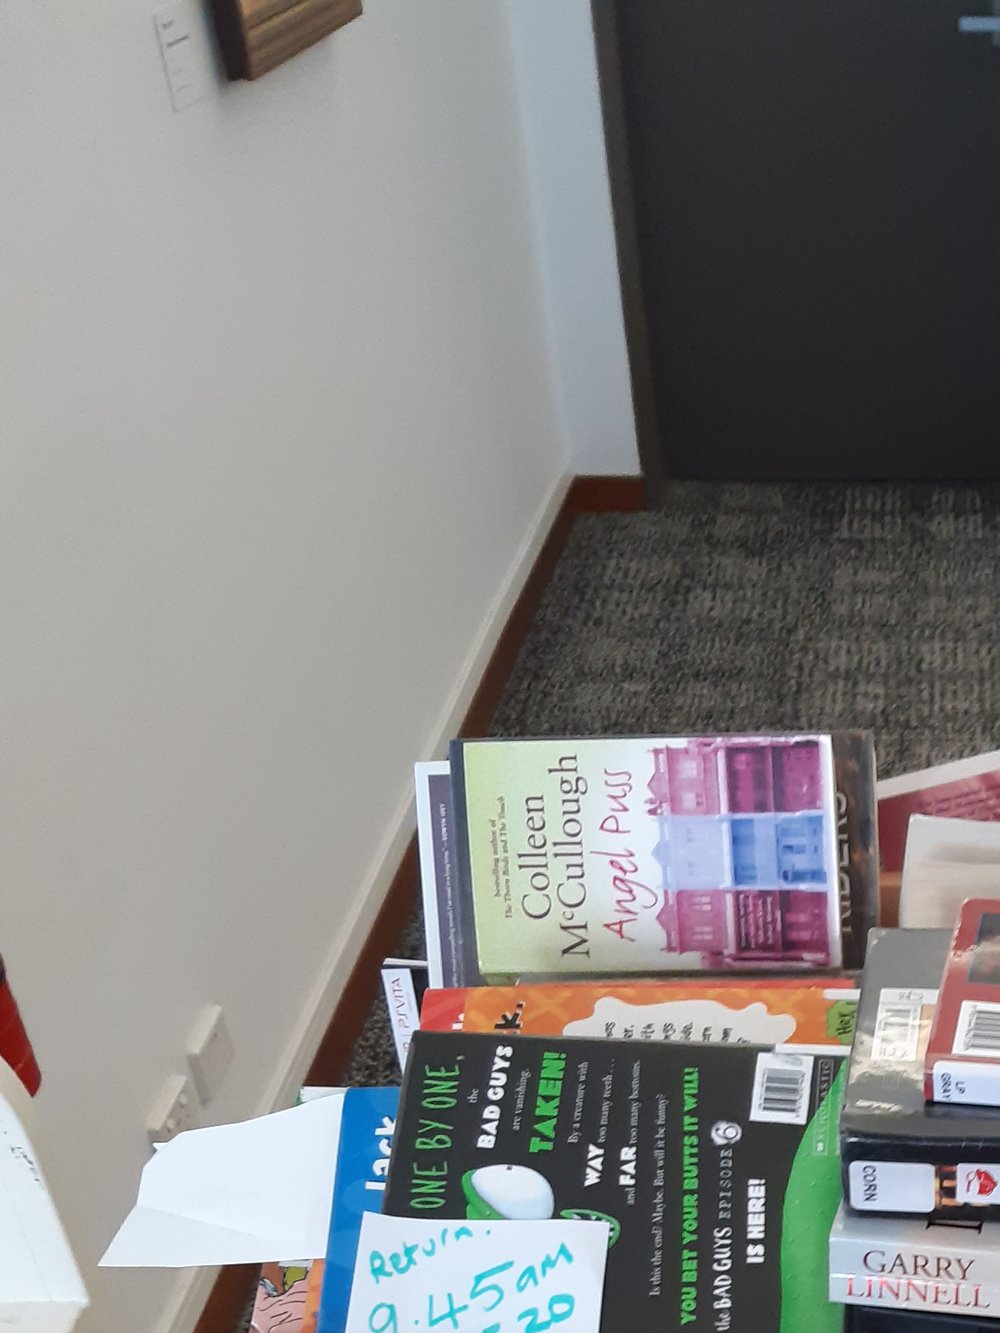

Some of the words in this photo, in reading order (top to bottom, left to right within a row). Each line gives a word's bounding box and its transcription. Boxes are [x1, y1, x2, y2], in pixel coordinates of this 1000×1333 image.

[599, 768, 634, 835] Puss
[491, 830, 500, 855] author
[517, 795, 552, 919] Colleen
[548, 753, 590, 959] McCullough
[493, 857, 502, 898] bestselling
[590, 850, 659, 942] Angel
[422, 1055, 465, 1110] ONE,
[487, 1045, 514, 1101] GUYS
[578, 1061, 589, 1086] with
[468, 1087, 479, 1104] the
[529, 1051, 567, 1153] TAKEN!
[573, 1088, 586, 1120] creature
[683, 1067, 700, 1113] WILL!
[476, 1104, 501, 1149] BAD
[511, 1113, 521, 1131] are
[601, 1101, 613, 1127] many
[630, 1100, 641, 1128] many
[683, 1115, 699, 1132] IT
[416, 1119, 454, 1150] BY
[567, 1127, 579, 1144] By
[599, 1128, 607, 1144] too
[628, 1129, 638, 1145] too
[655, 1126, 665, 1138] be
[583, 1143, 607, 1189] WAY
[618, 1145, 638, 1187] FAR
[654, 1150, 664, 1166] will
[683, 1135, 699, 1191] BUTTS
[410, 1160, 448, 1210] ONE
[653, 1168, 663, 1186] But
[718, 1148, 734, 1219] EPISODE
[861, 1165, 878, 1202] CORN
[625, 1187, 636, 1205] and
[652, 1190, 666, 1223] Maybe.
[747, 1178, 766, 1233] HERE!
[682, 1194, 699, 1246] YOUR
[652, 1227, 662, 1248] end?
[713, 1226, 734, 1272] GUYS
[747, 1236, 765, 1264] IS
[651, 1251, 661, 1266] the
[681, 1249, 698, 1280] BET
[862, 1249, 976, 1281] GARRY
[650, 1287, 660, 1297] Is
[651, 1268, 661, 1286] this
[713, 1273, 733, 1308] BAD
[847, 1272, 991, 1309] LINNELL
[680, 1283, 698, 1326] YOU
[716, 1307, 730, 1331] the
